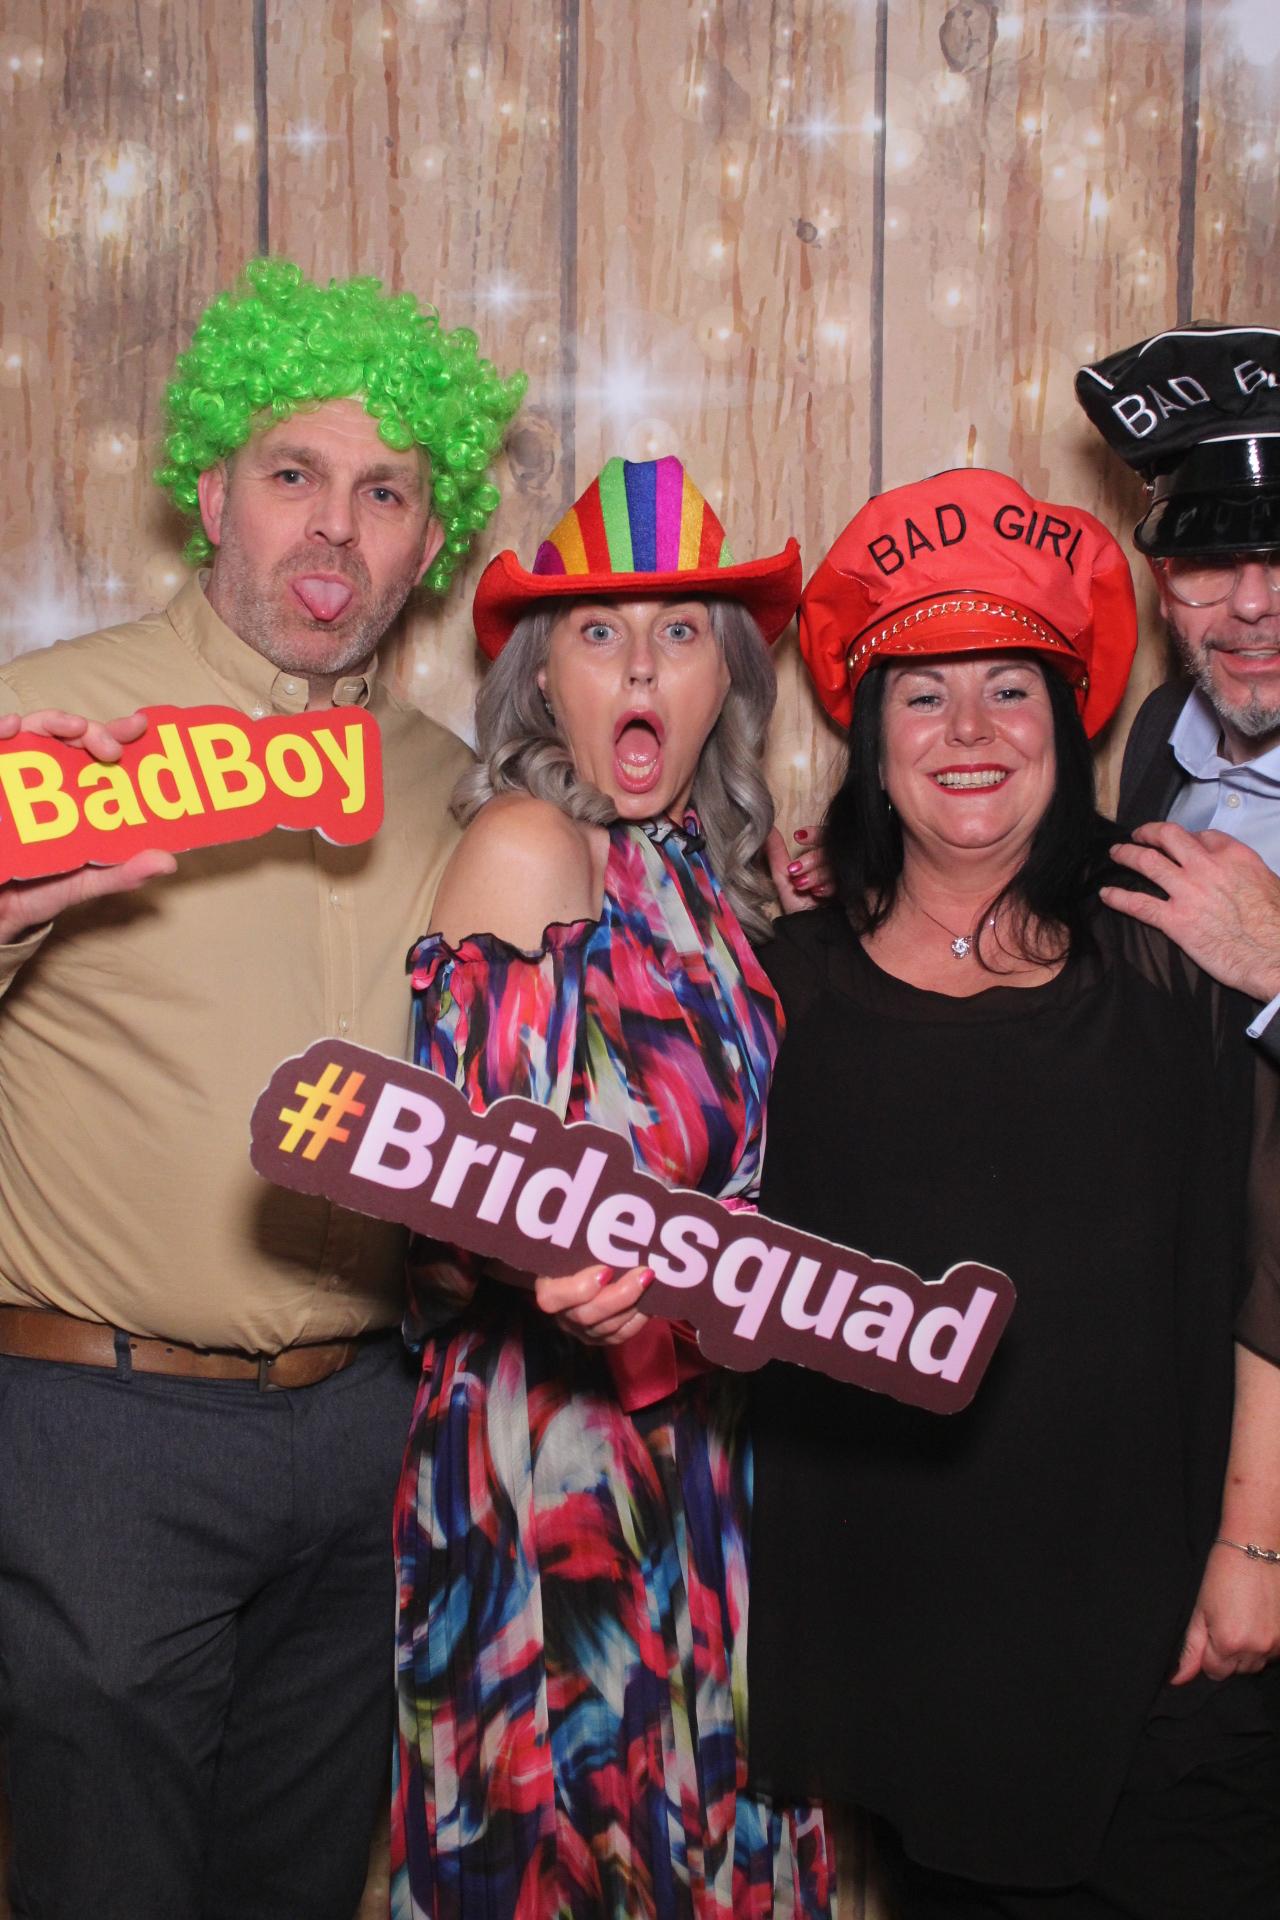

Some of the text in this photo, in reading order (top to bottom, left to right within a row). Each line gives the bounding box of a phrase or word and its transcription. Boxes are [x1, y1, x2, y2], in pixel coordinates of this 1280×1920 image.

[1111, 376, 1211, 439] BAD
[867, 503, 1083, 576] BAD GIRL
[278, 1062, 998, 1384] #Bridesquad
